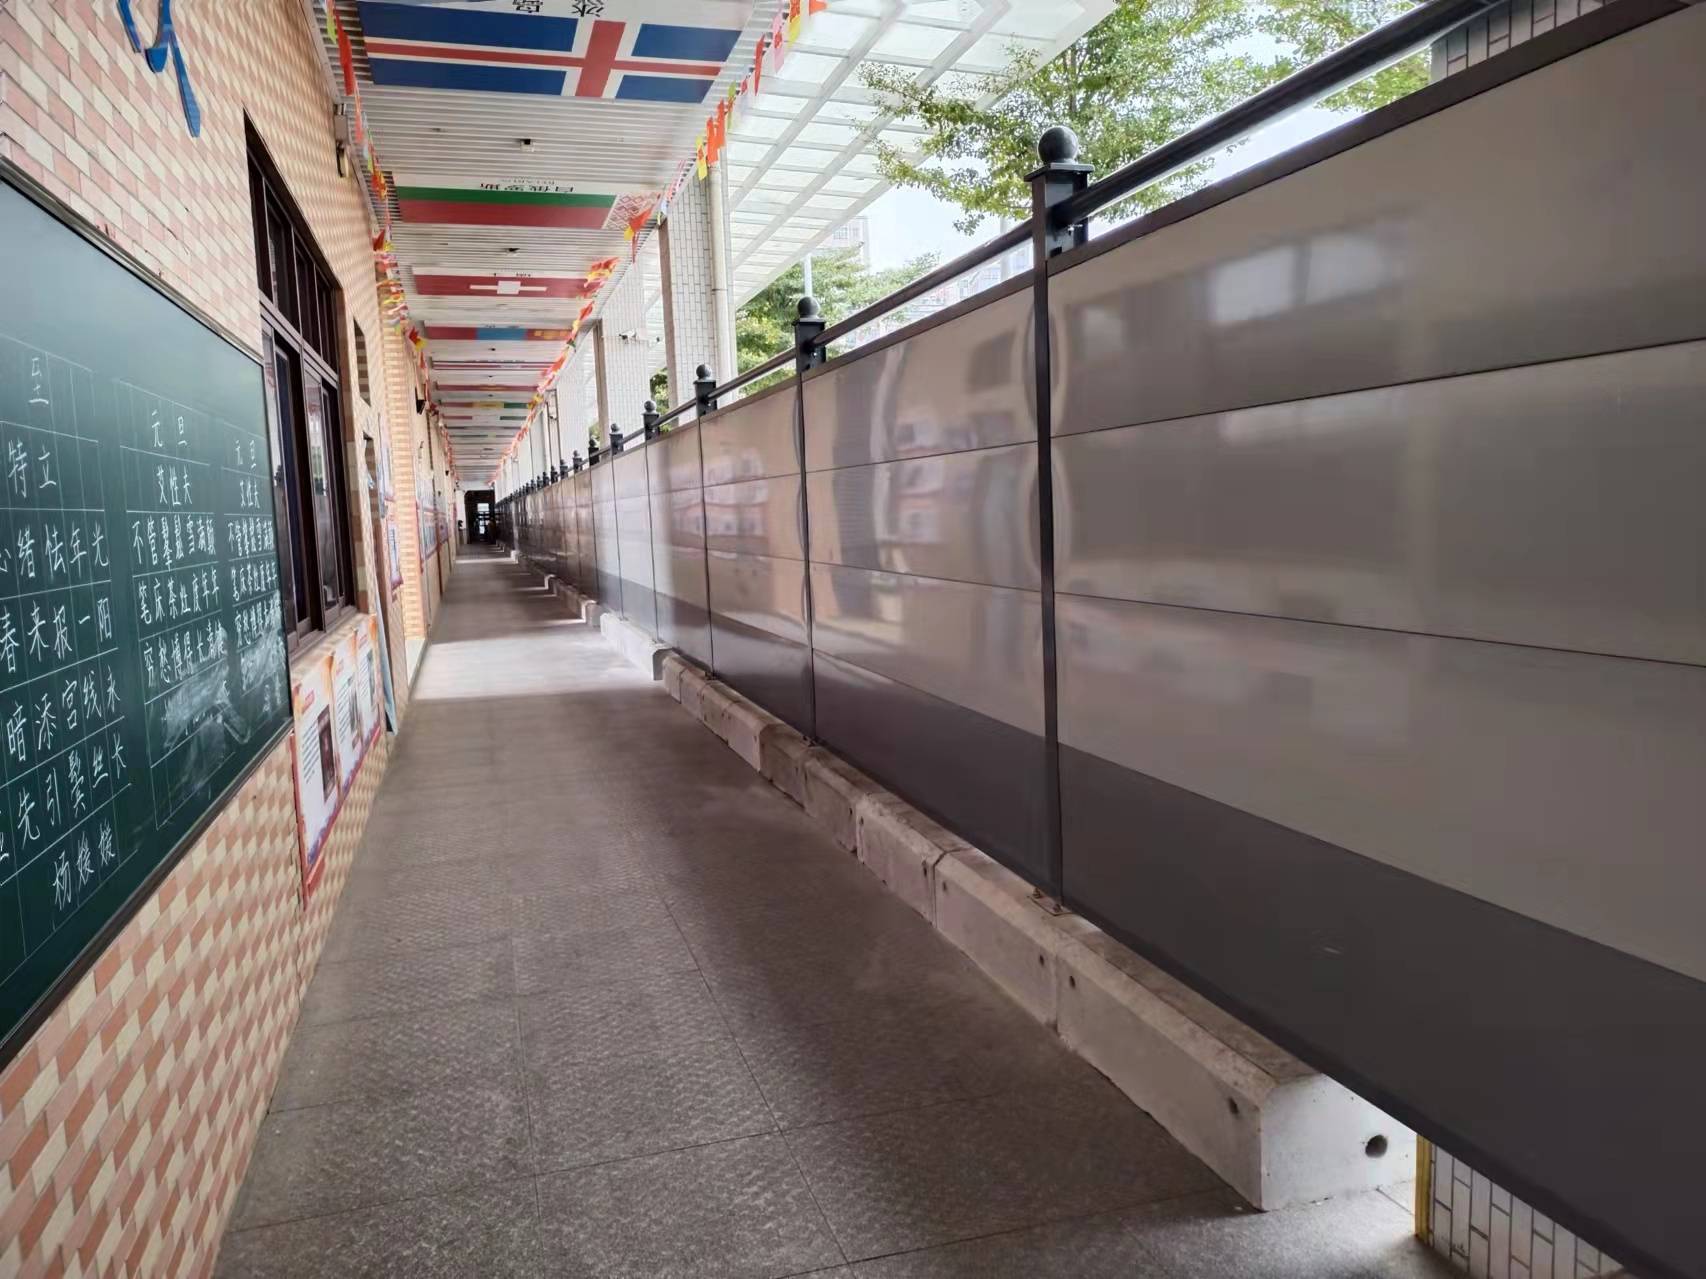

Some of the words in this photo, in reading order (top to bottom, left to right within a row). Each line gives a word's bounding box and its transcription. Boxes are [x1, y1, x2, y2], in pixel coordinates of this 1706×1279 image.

[151, 408, 188, 448] 元旦
[8, 437, 57, 498] 特立
[0, 598, 112, 673] 春来报一阳
[7, 664, 121, 762] 暗添宫线永
